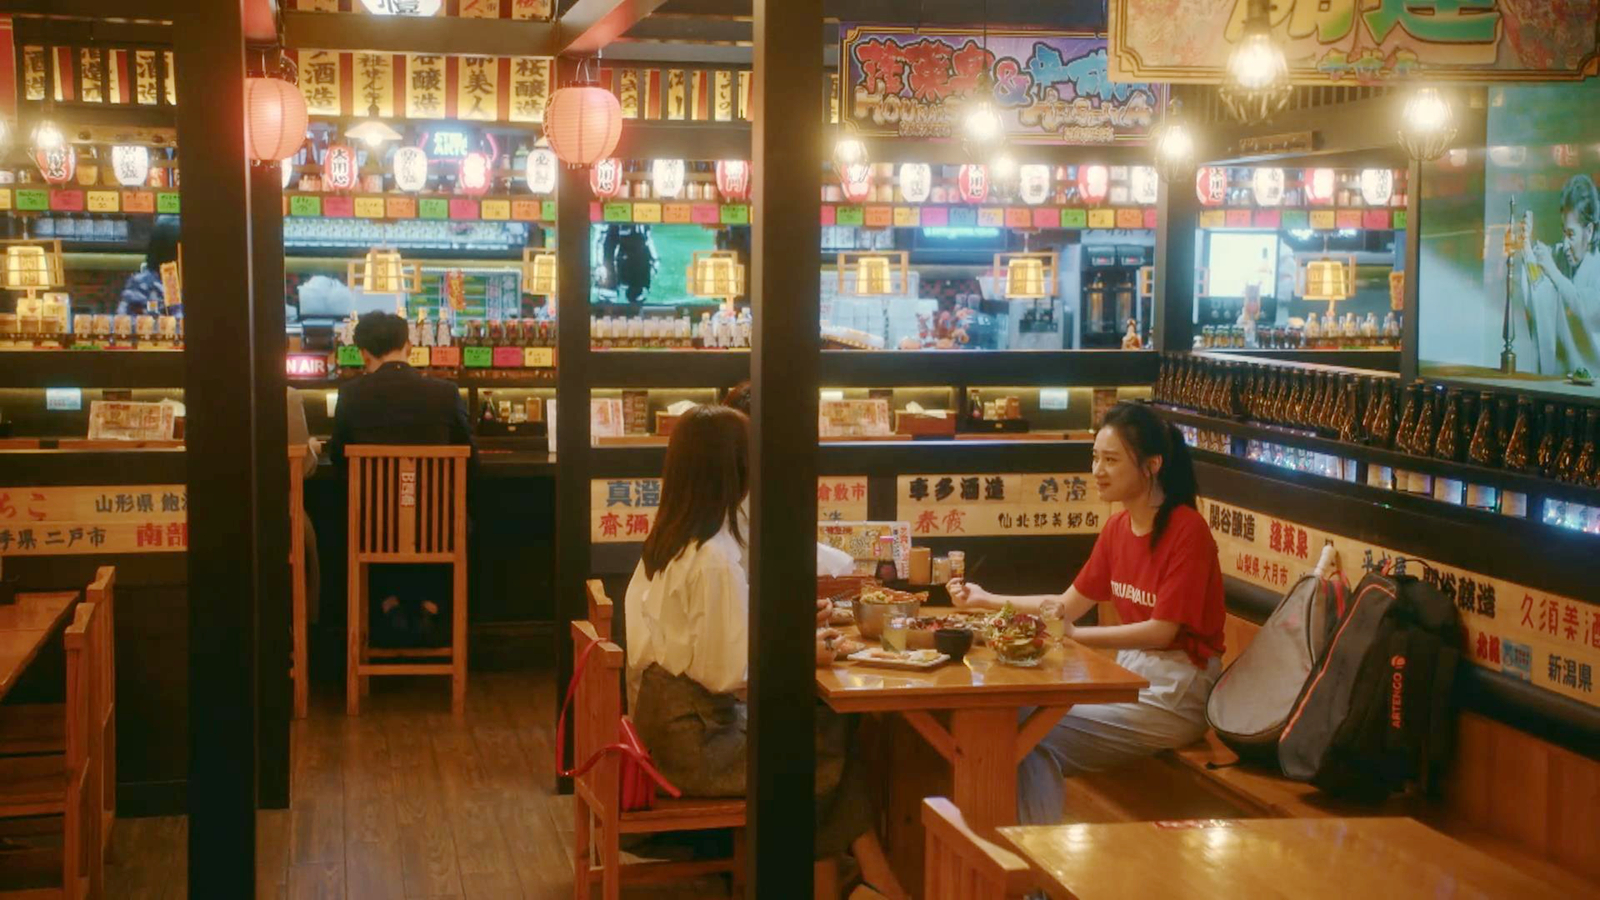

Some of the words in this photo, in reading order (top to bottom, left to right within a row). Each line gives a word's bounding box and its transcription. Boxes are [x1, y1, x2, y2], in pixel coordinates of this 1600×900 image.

[299, 359, 325, 374] AIR
[909, 477, 1005, 501] 車多酒造
[914, 508, 966, 534] 春霞
[1391, 672, 1402, 729] ARTENGO
